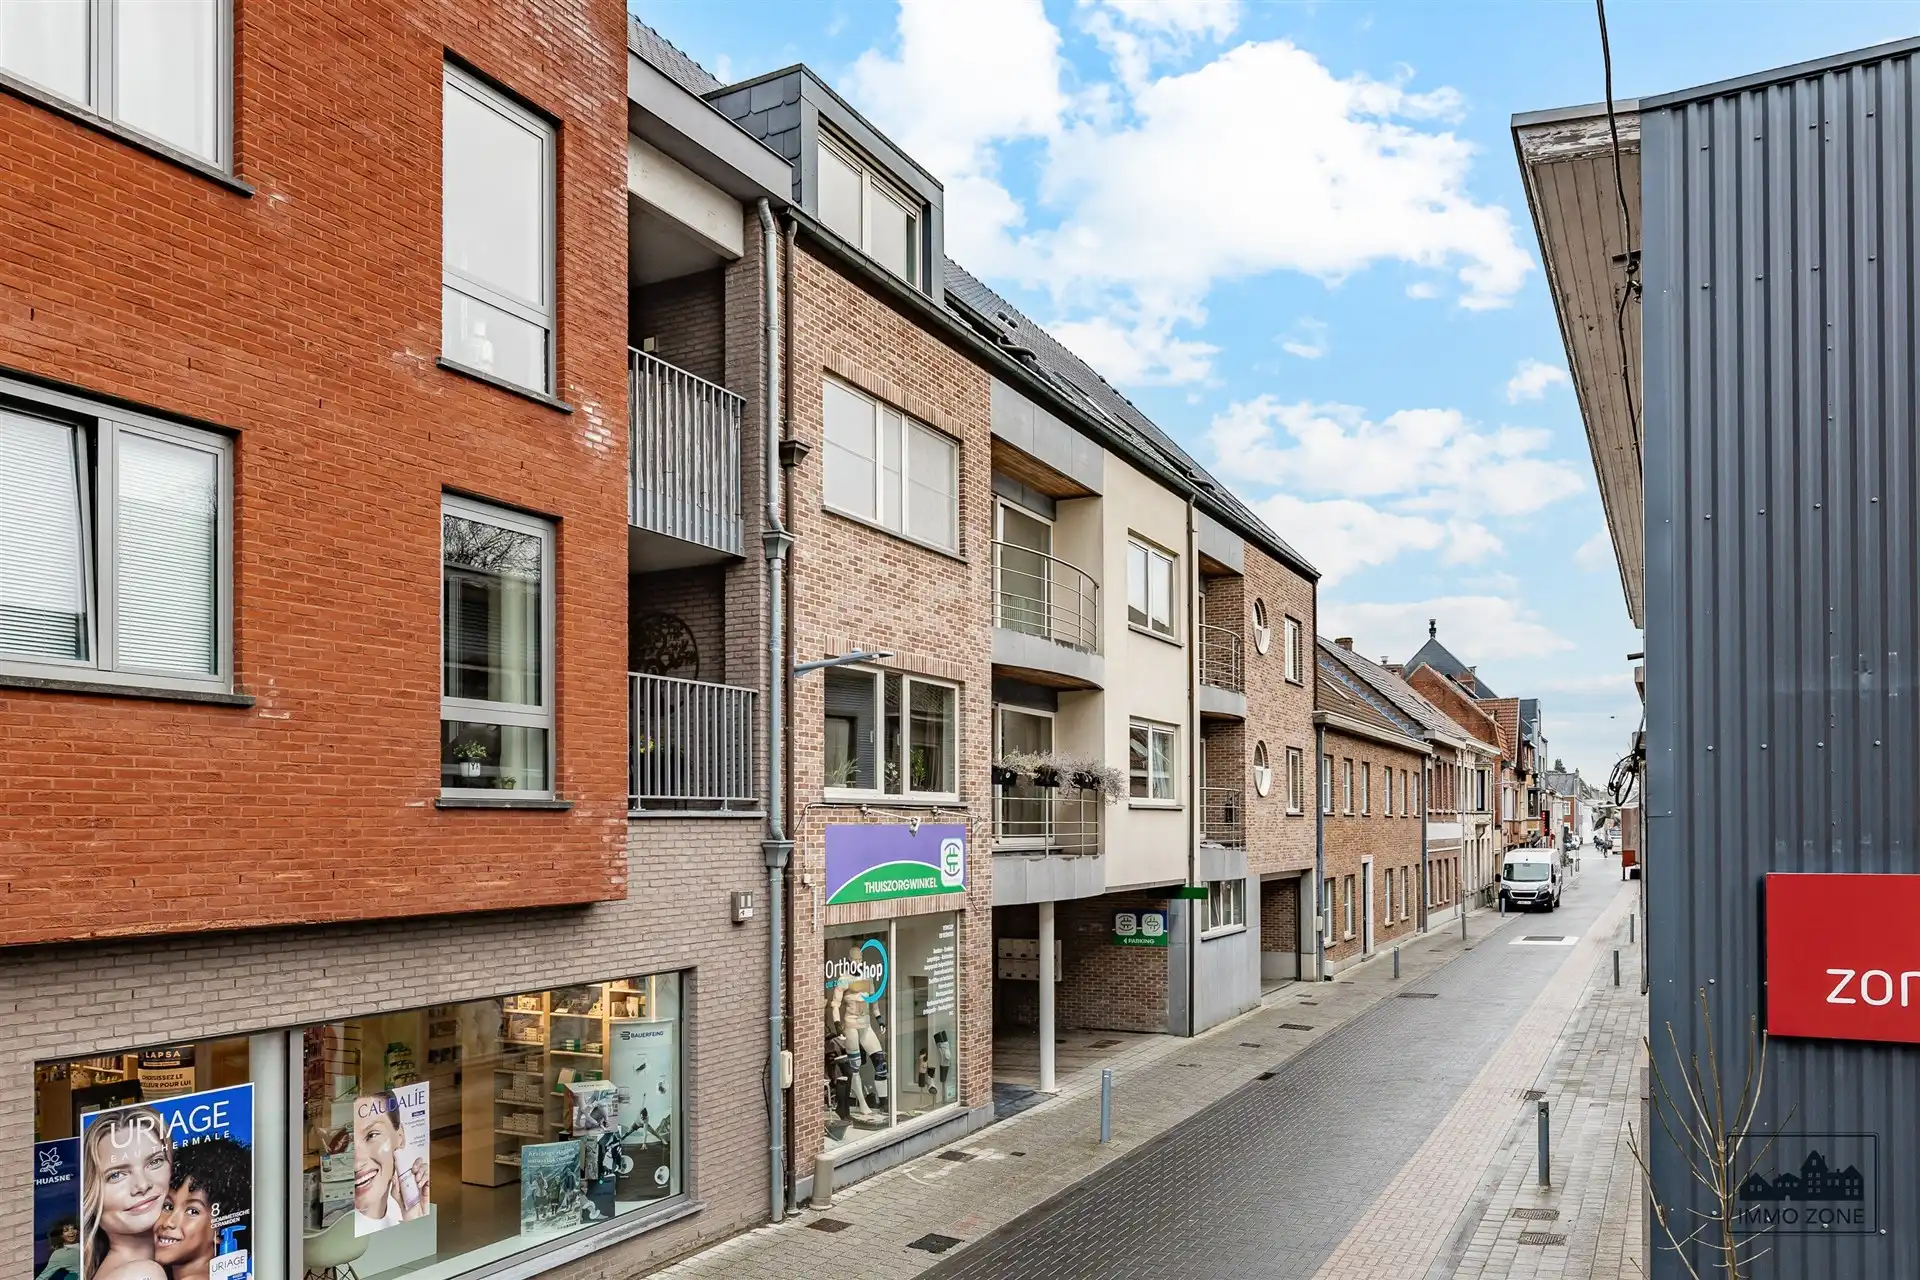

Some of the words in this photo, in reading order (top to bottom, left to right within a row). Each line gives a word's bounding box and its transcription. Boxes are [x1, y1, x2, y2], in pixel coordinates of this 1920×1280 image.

[864, 877, 938, 894] THUISZORGWINKEL
[160, 1080, 180, 1088] POUR
[358, 1088, 426, 1119] CAUDALÍE
[110, 1100, 230, 1149] URIAGE
[110, 1149, 142, 1164] EAU
[151, 1130, 231, 1154] THERMALE
[211, 1202, 220, 1217] 8
[211, 1255, 246, 1273] URIAGE
